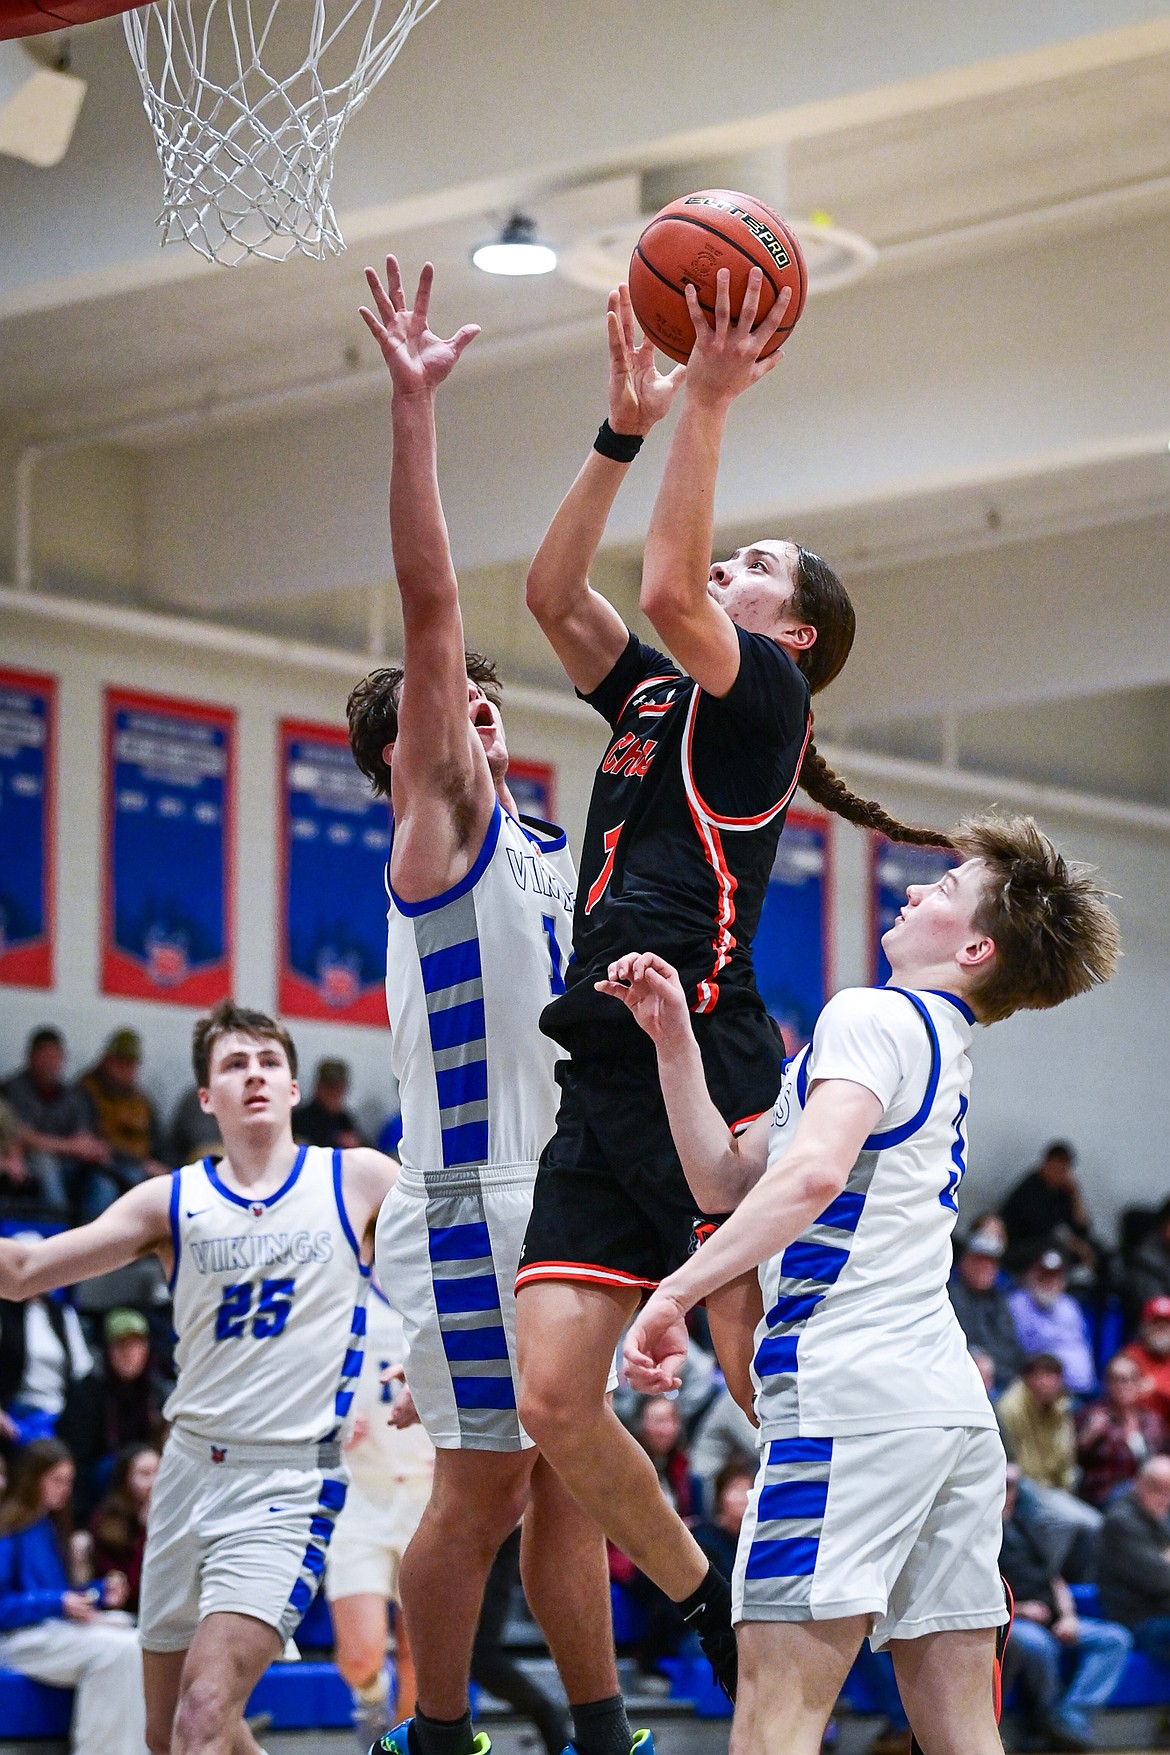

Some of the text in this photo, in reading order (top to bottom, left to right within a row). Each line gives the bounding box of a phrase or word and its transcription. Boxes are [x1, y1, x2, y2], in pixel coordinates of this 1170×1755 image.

[757, 224, 791, 268] PRO
[540, 911, 568, 997] 1
[189, 1229, 335, 1275] VIKINGS
[215, 1277, 297, 1342] 25
